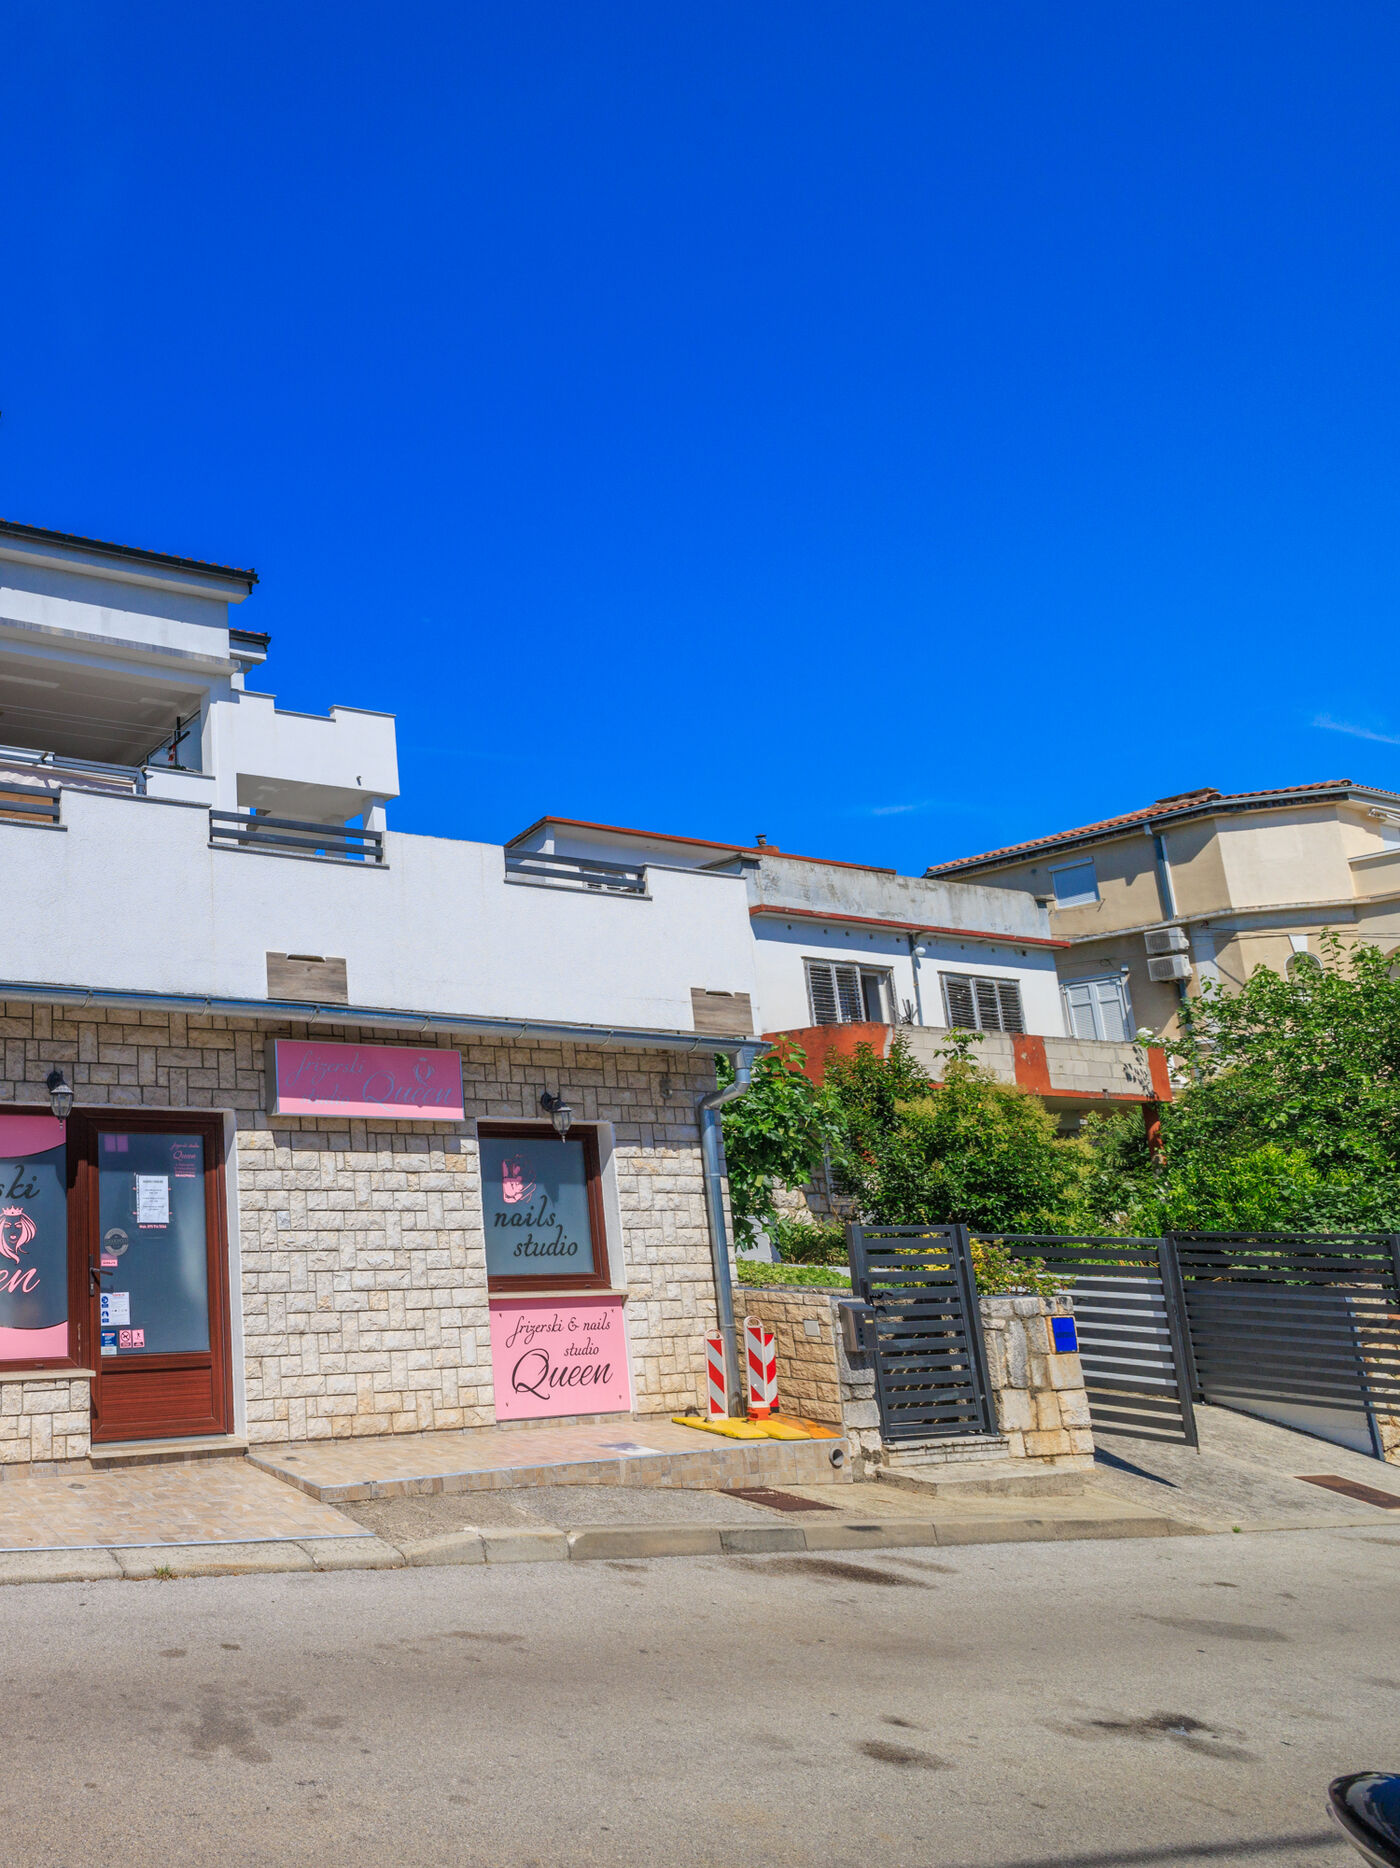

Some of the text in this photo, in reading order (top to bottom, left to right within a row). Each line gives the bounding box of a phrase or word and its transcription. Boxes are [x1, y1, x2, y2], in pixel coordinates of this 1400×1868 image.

[286, 1050, 365, 1087] frizerski
[299, 1083, 351, 1106] studio
[362, 1070, 453, 1112] Queen
[494, 1195, 556, 1228] nails
[513, 1224, 578, 1257] studio
[505, 1312, 611, 1349] frizerski & nails
[563, 1337, 600, 1357] studio
[512, 1348, 613, 1400] Queen
